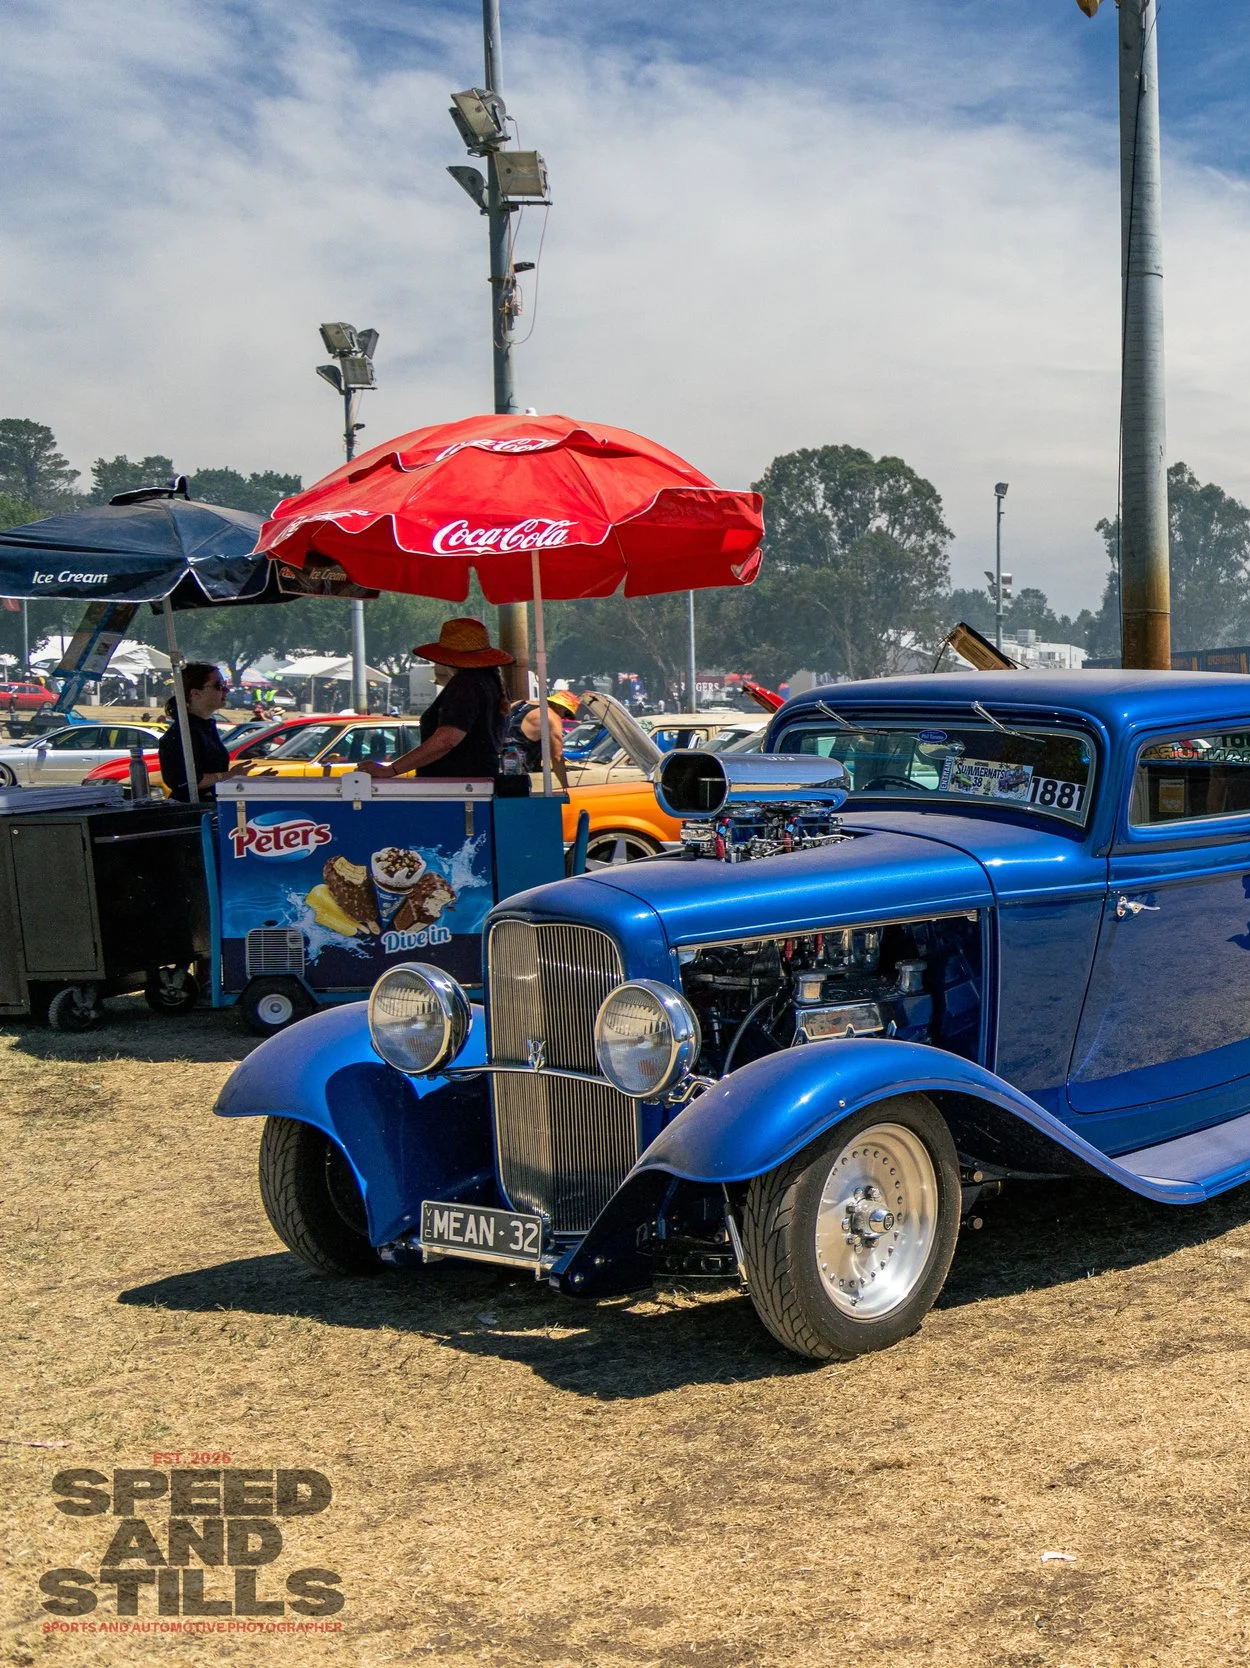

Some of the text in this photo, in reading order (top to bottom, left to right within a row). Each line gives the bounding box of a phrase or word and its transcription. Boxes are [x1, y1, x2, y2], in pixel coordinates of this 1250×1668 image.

[433, 518, 579, 554] Coca-Cola
[32, 570, 109, 584] Ice Cream
[309, 567, 321, 579] Ice
[956, 763, 1005, 780] SUMMERNATS
[972, 777, 983, 787] 38
[1030, 777, 1086, 811] 1881
[229, 821, 332, 857] Peters
[383, 926, 450, 953] Dive in
[424, 1208, 433, 1238] VIC
[434, 1210, 538, 1253] MEAN 32
